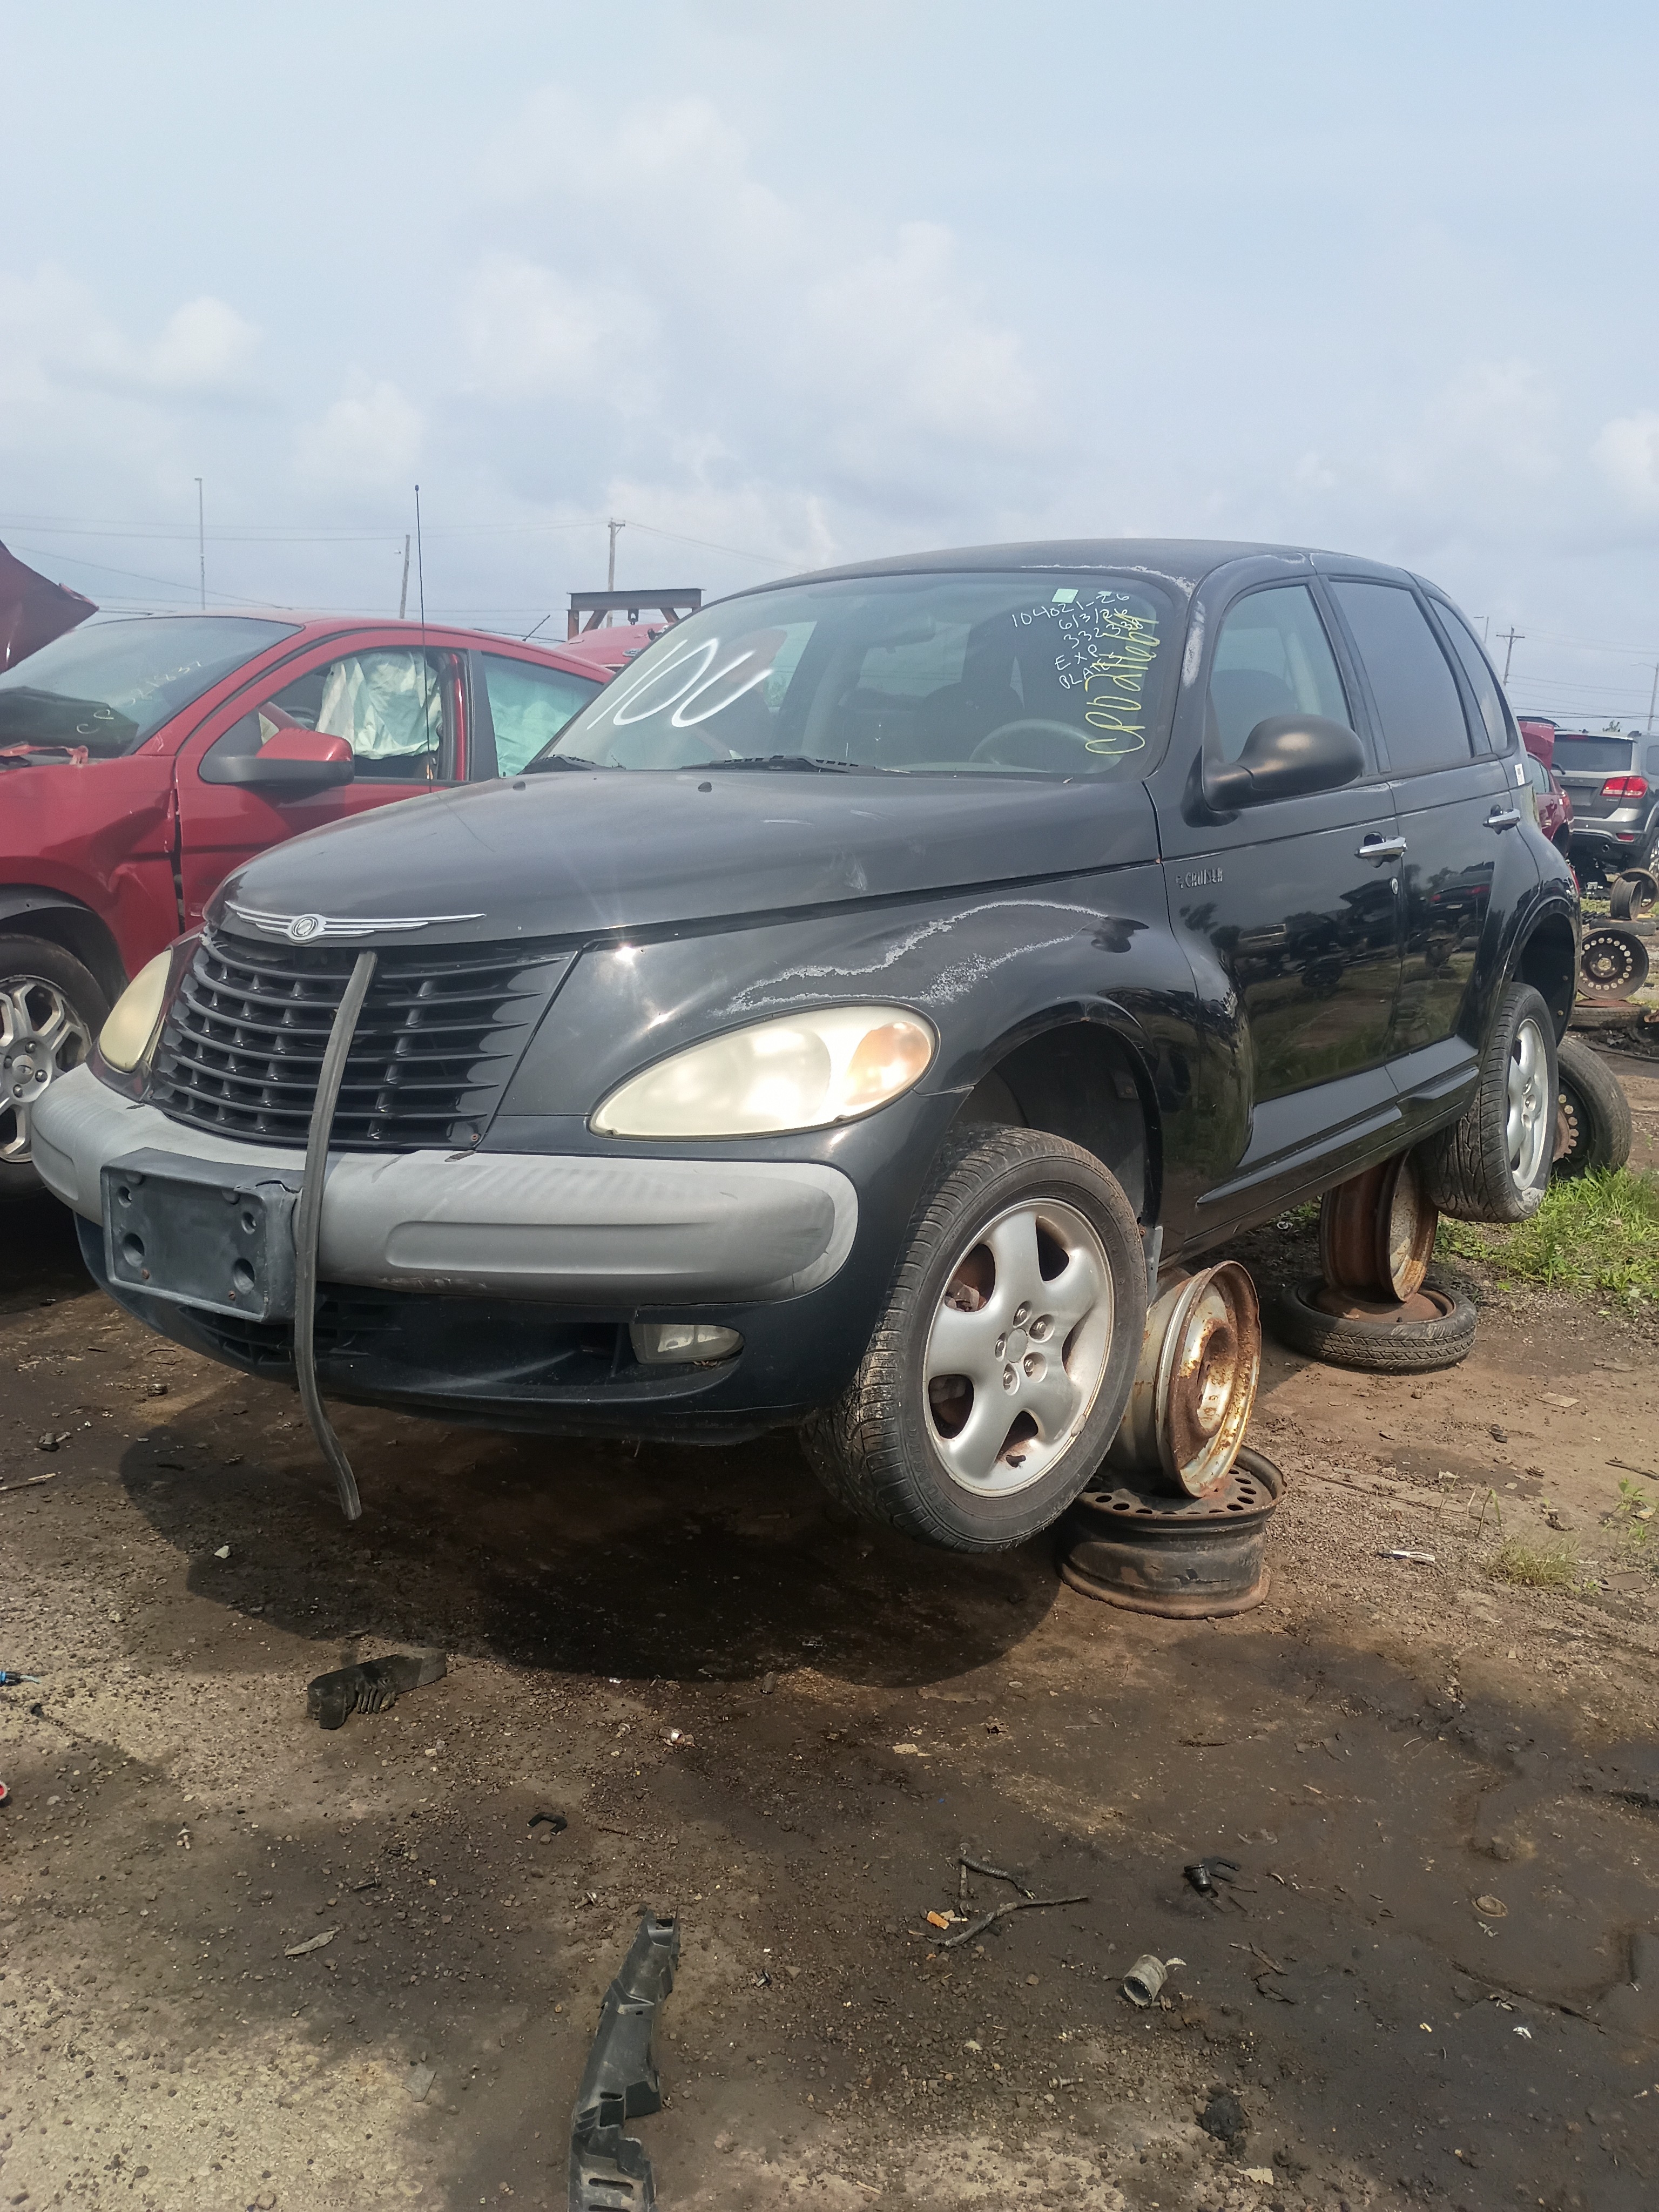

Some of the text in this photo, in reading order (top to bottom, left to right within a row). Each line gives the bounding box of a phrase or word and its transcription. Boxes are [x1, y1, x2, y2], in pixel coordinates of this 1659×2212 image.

[1012, 594, 1130, 628] 104021-26
[1055, 644, 1098, 670] EXP
[1185, 867, 1223, 888] CRUISER
